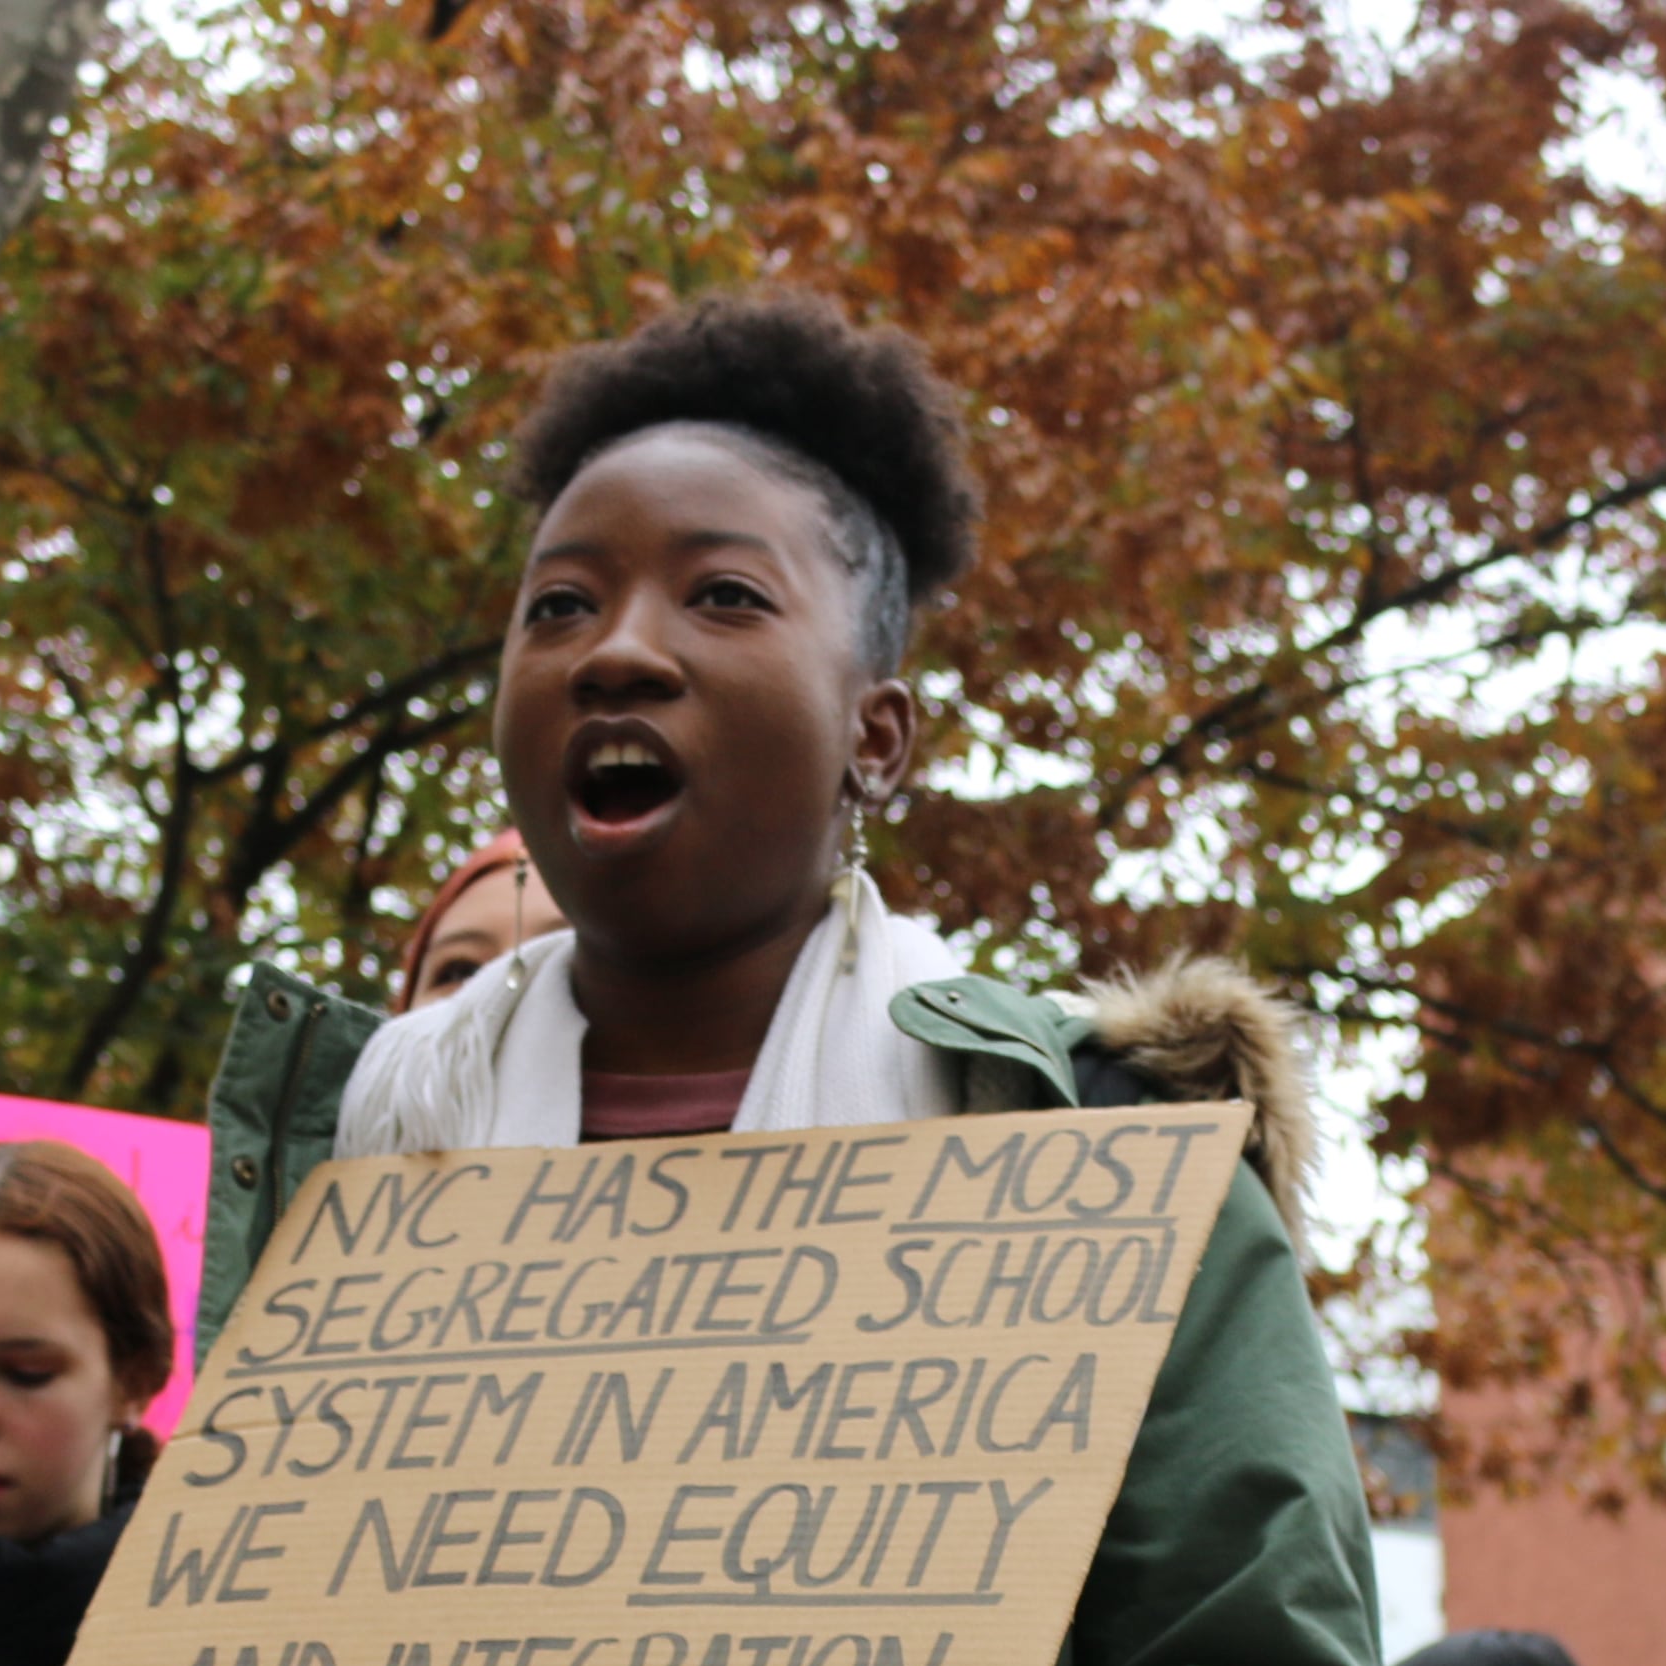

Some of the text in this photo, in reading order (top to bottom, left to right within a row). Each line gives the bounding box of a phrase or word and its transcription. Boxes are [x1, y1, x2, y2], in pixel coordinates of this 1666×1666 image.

[290, 1122, 1220, 1266] NYC HAS THE MOST
[236, 1244, 840, 1367] SEGREGATED
[854, 1226, 1179, 1334] SCHOOL
[183, 1351, 1098, 1488] SYSTEM IN AMERICA
[147, 1475, 1056, 1608] WE NEED EQUITY
